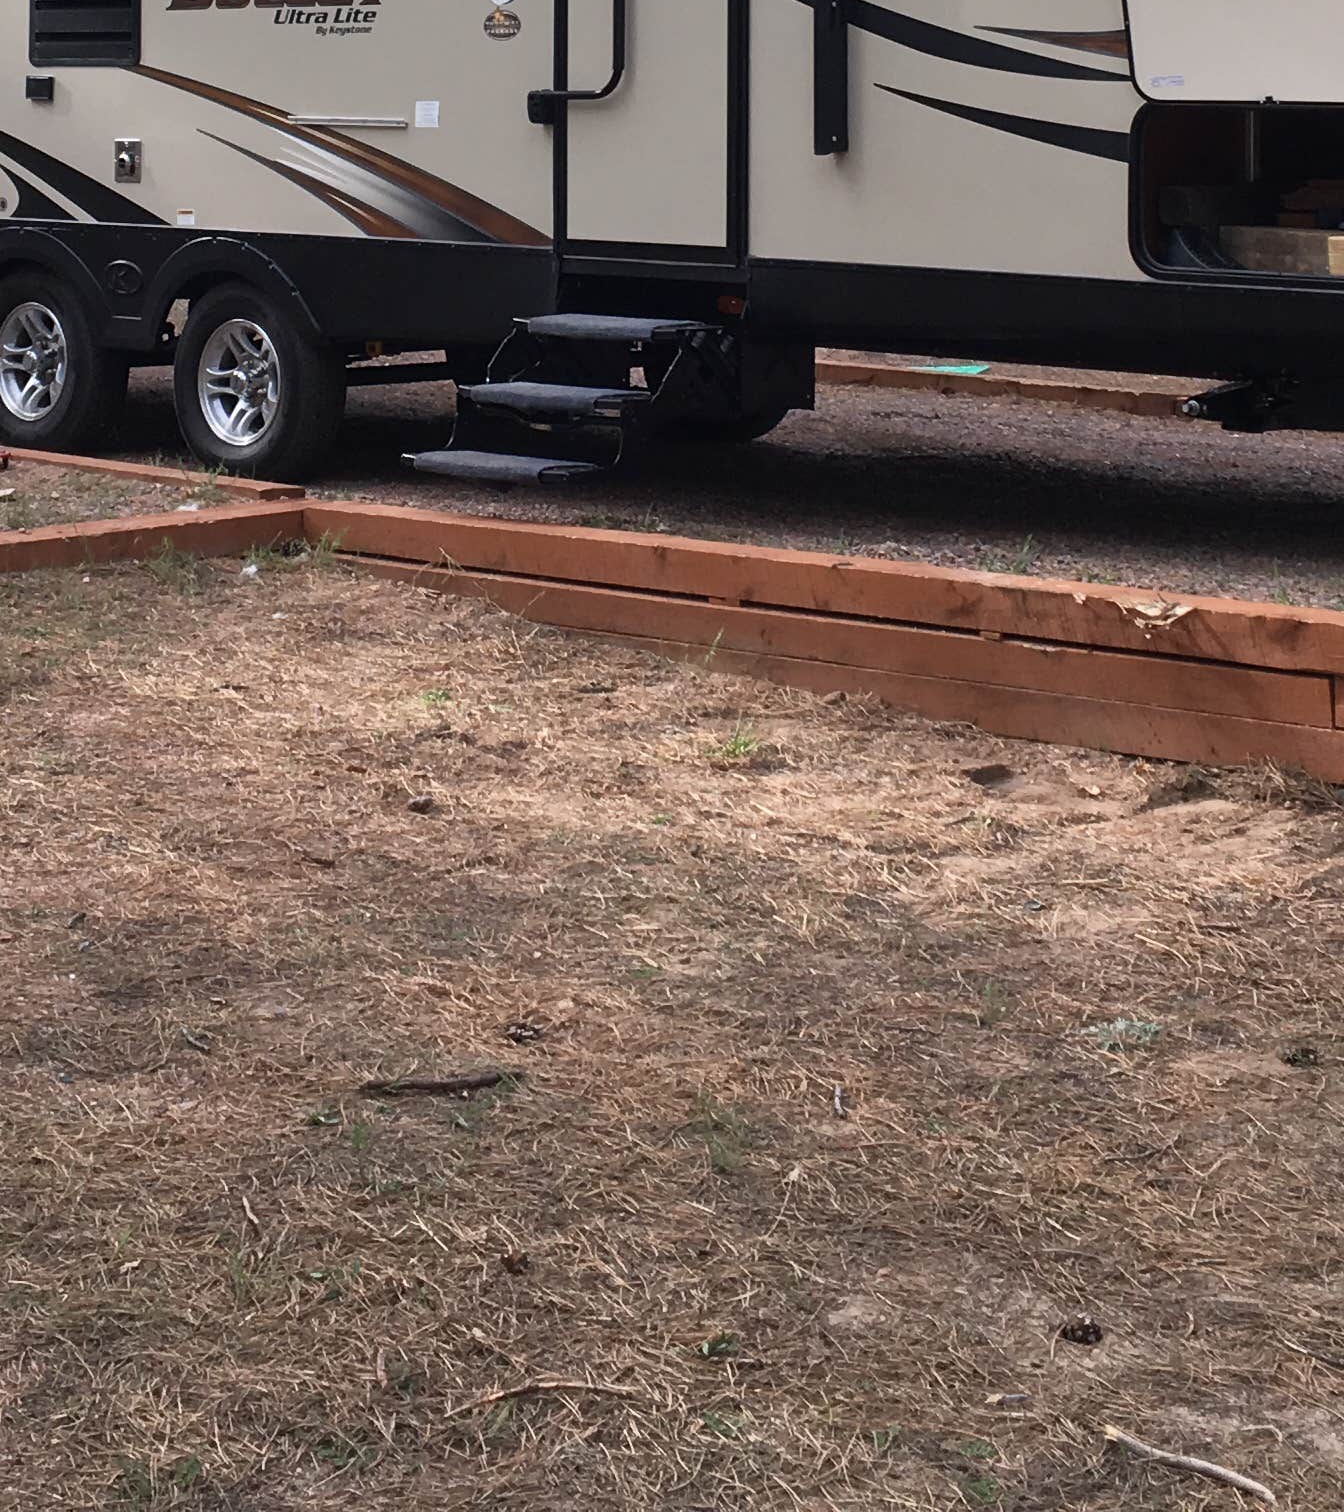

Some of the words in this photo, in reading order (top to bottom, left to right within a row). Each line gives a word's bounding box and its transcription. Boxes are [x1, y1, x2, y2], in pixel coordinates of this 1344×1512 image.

[274, 9, 328, 24] Ultra
[333, 8, 377, 23] Lite
[316, 26, 327, 36] By
[329, 26, 373, 36] Keystone
